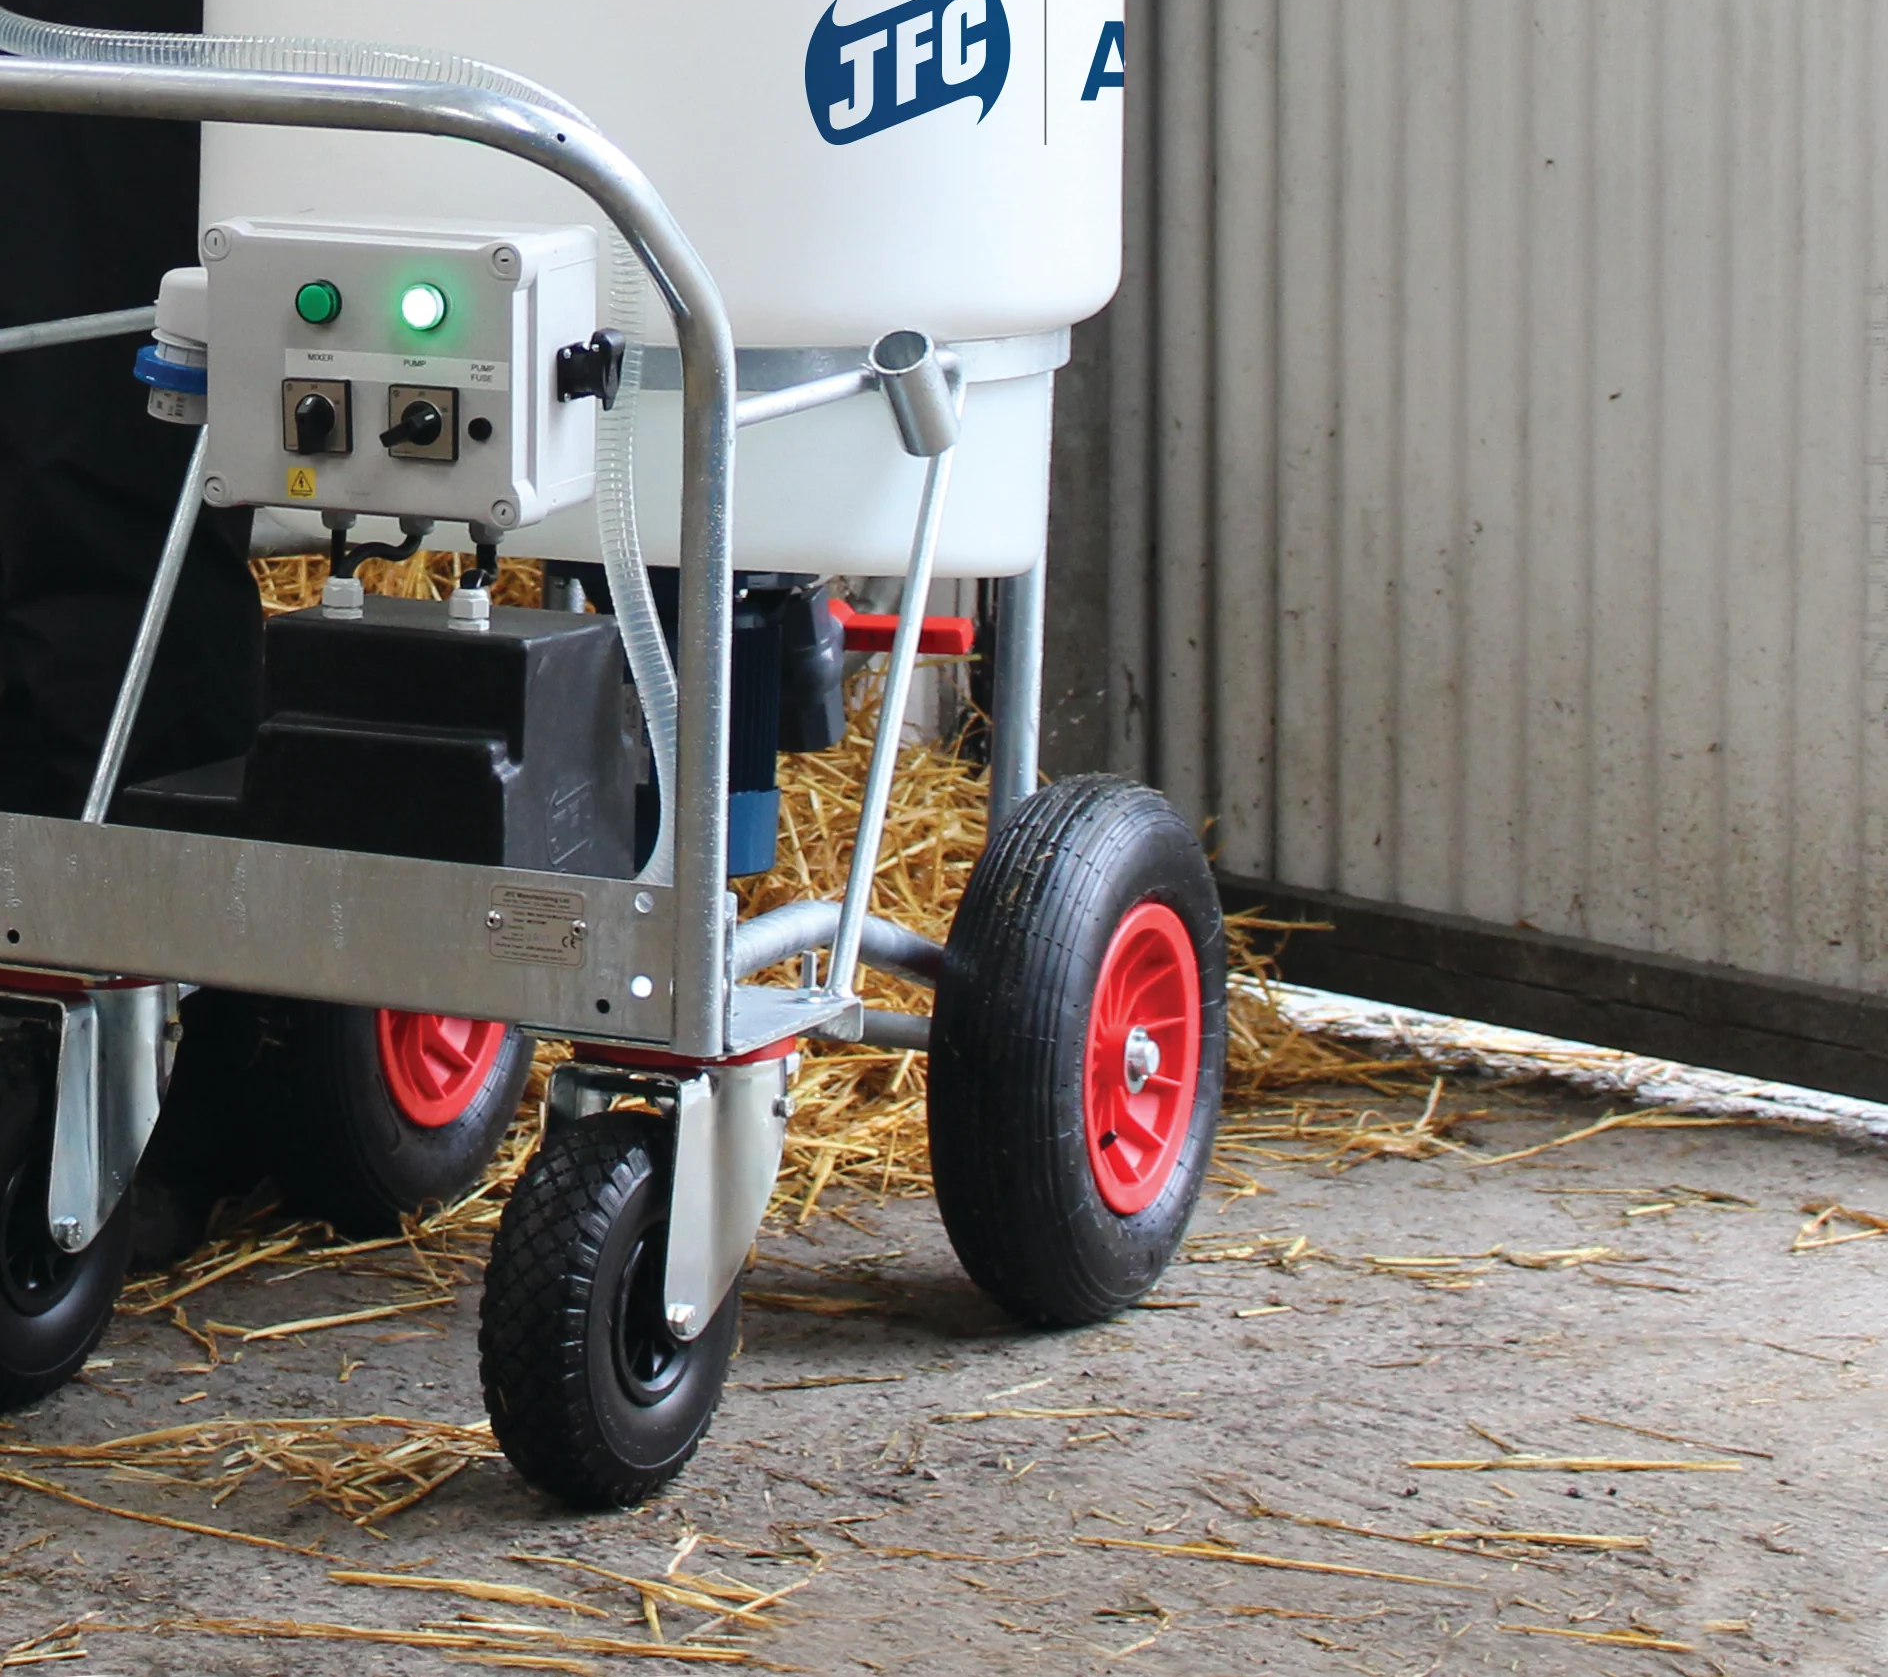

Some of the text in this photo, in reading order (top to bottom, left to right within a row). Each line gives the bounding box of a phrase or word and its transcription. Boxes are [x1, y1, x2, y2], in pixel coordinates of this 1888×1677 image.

[307, 353, 334, 362] MIXER
[403, 359, 427, 368] PUMP
[470, 364, 495, 373] PUMP
[470, 374, 493, 383] FUSE
